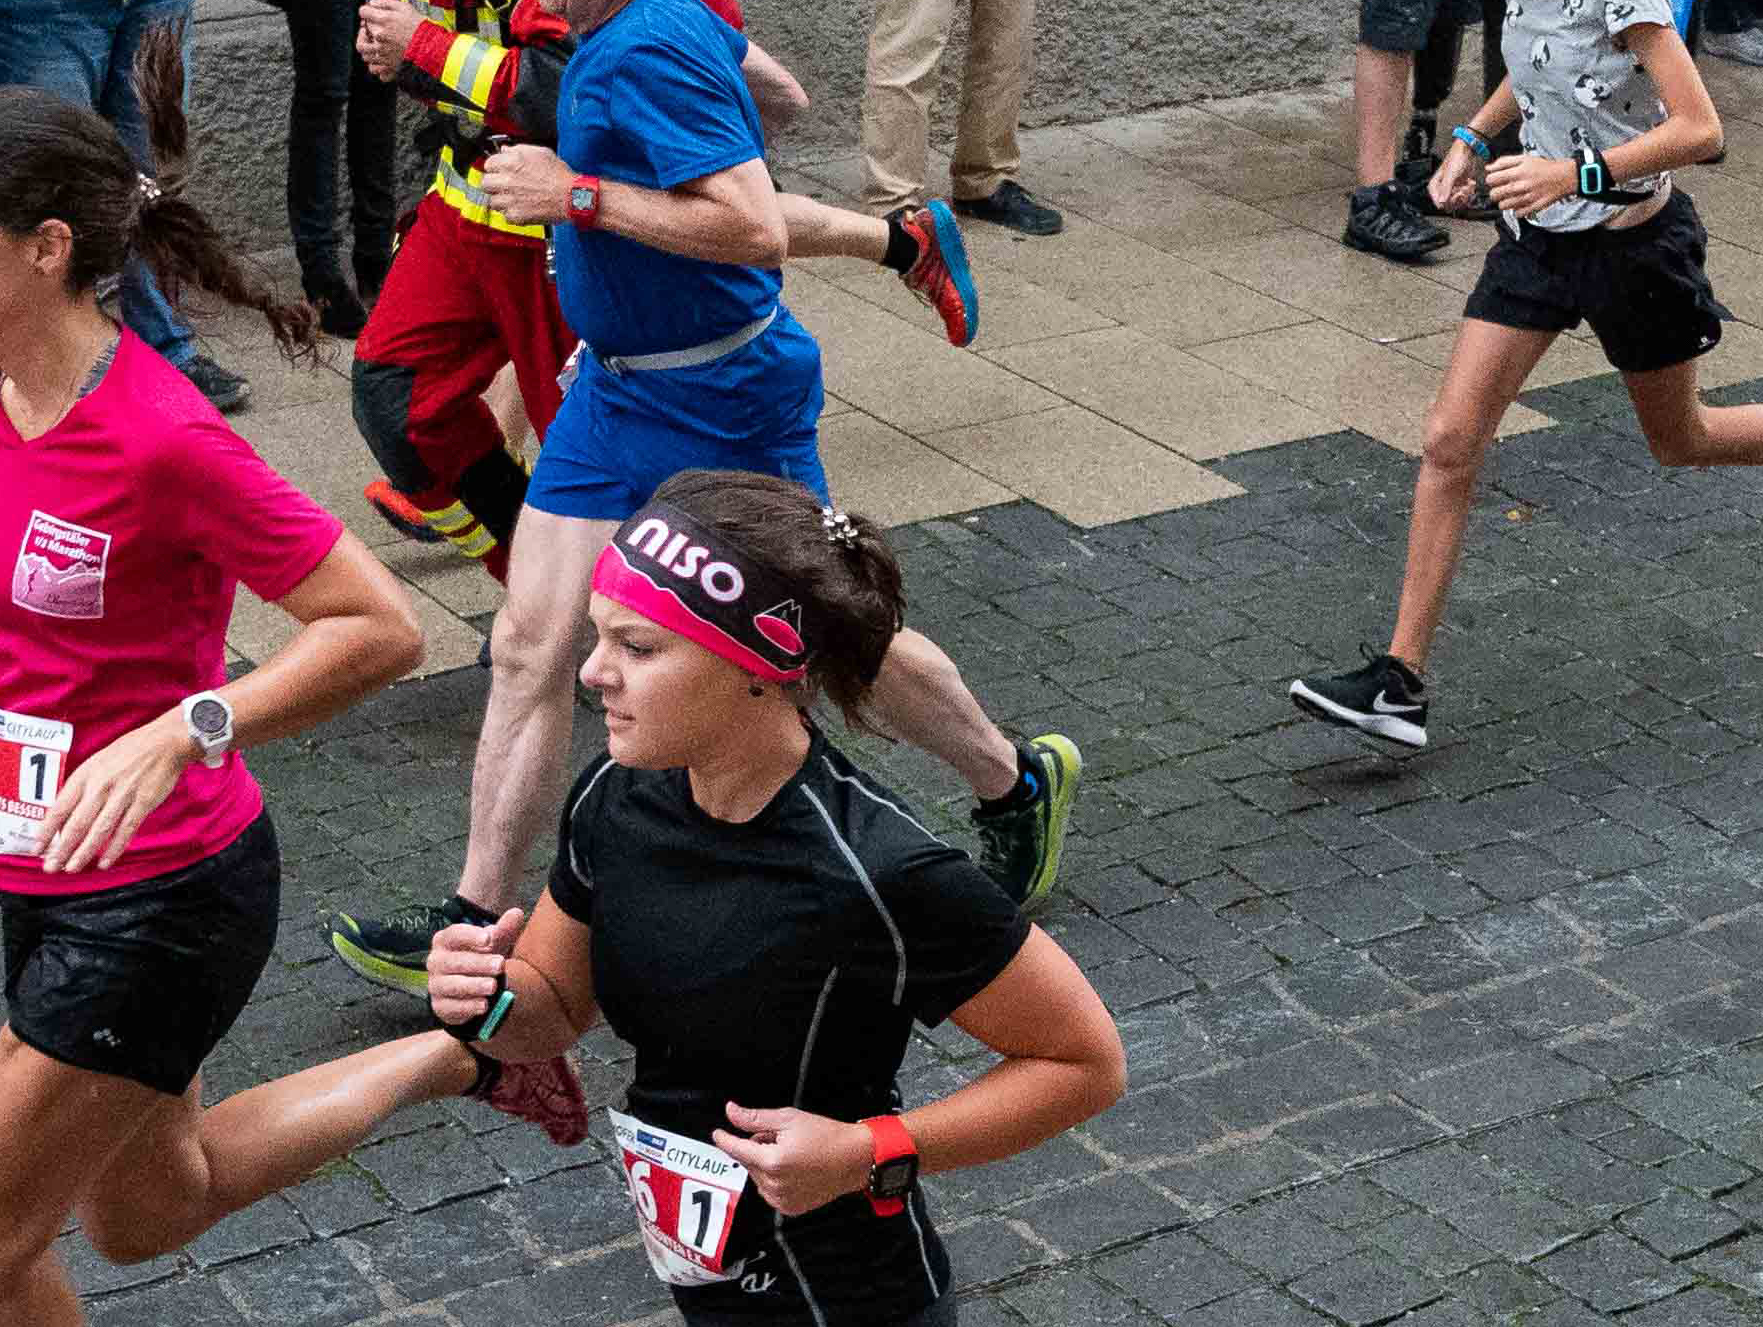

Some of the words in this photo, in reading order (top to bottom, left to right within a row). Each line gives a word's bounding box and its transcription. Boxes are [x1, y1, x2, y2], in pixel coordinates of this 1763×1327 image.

[47, 541, 101, 563] Marathon
[6, 722, 59, 740] CITYLAUF
[30, 753, 47, 801] 1
[7, 801, 45, 820] BESSER
[666, 1147, 729, 1177] CITYLAUF
[630, 1160, 658, 1223] 6
[691, 1190, 713, 1249] 1
